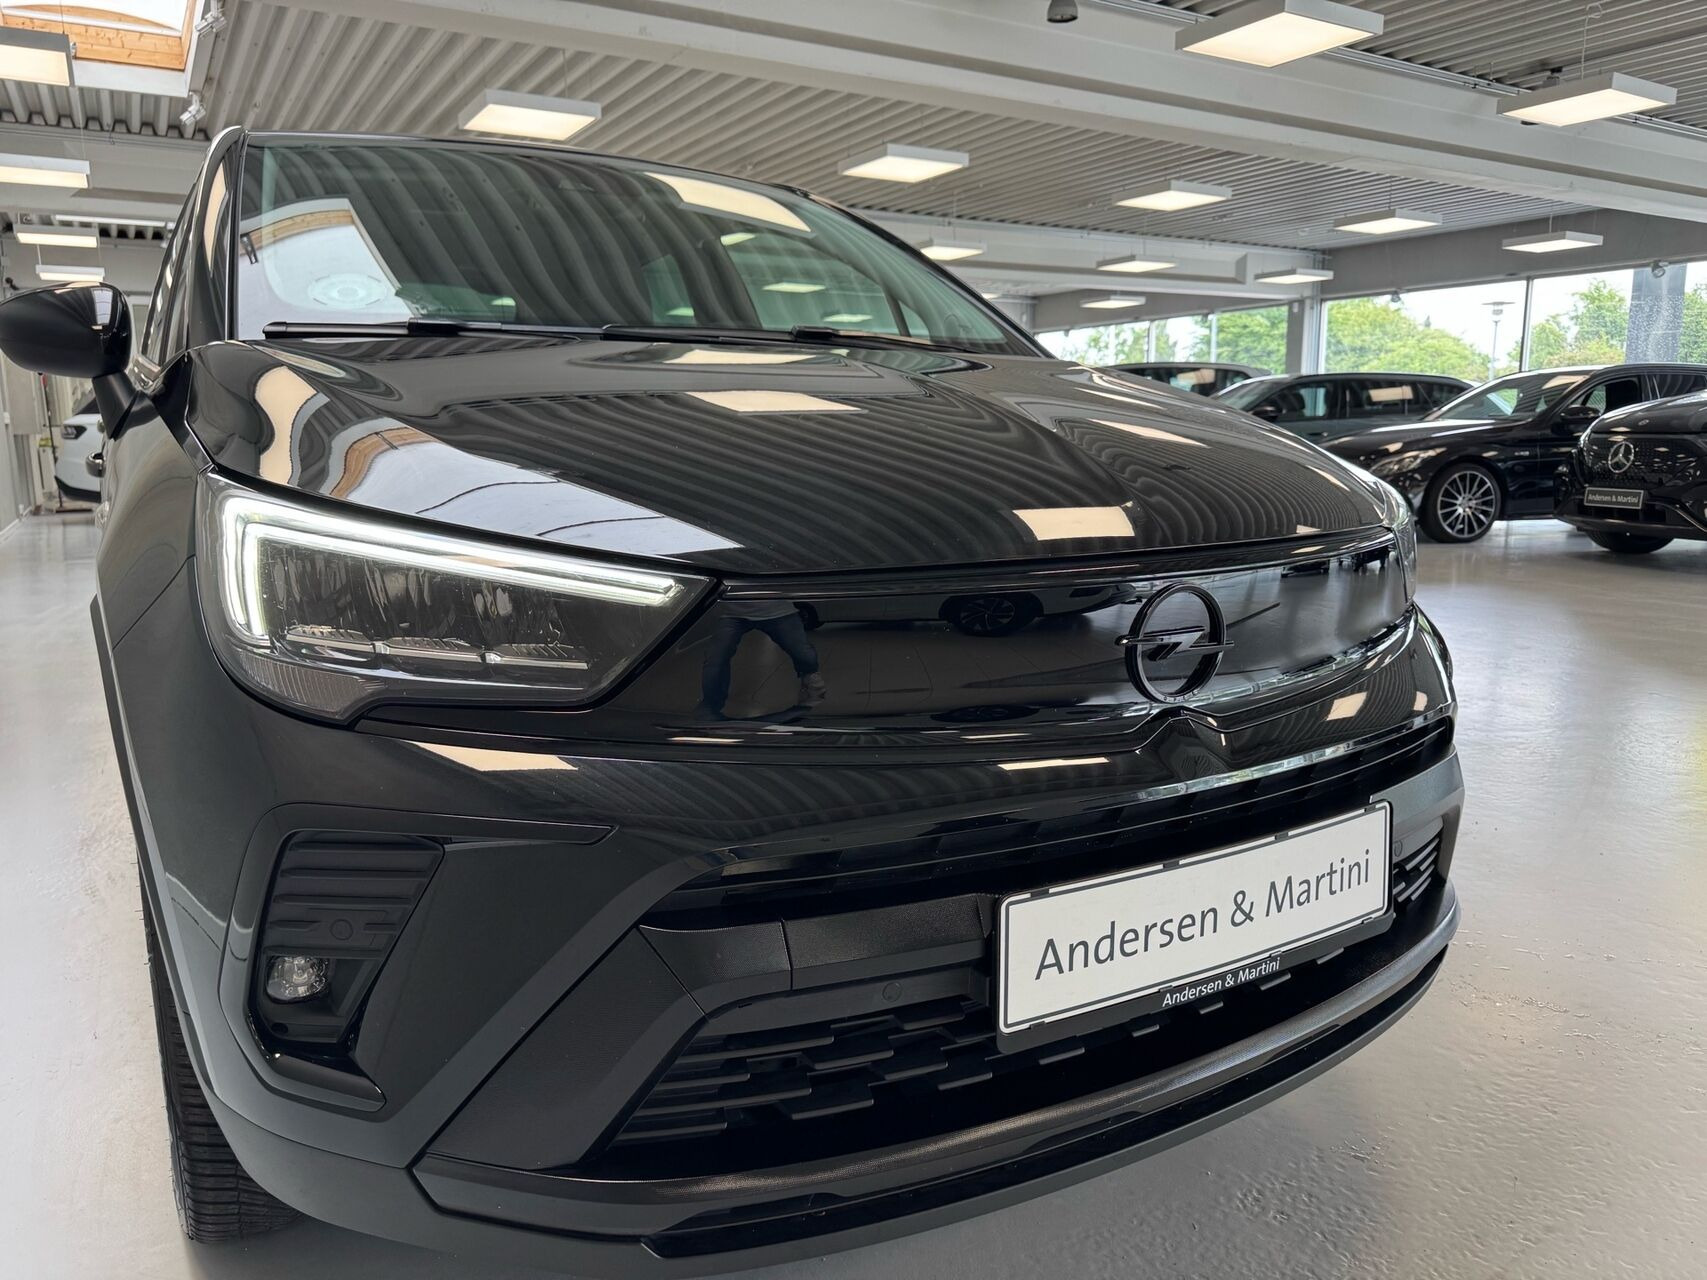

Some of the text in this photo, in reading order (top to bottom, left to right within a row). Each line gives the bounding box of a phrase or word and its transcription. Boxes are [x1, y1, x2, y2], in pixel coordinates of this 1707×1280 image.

[1035, 848, 1370, 980] Andersen & Martini
[1162, 957, 1280, 1007] Andersen & Martini
